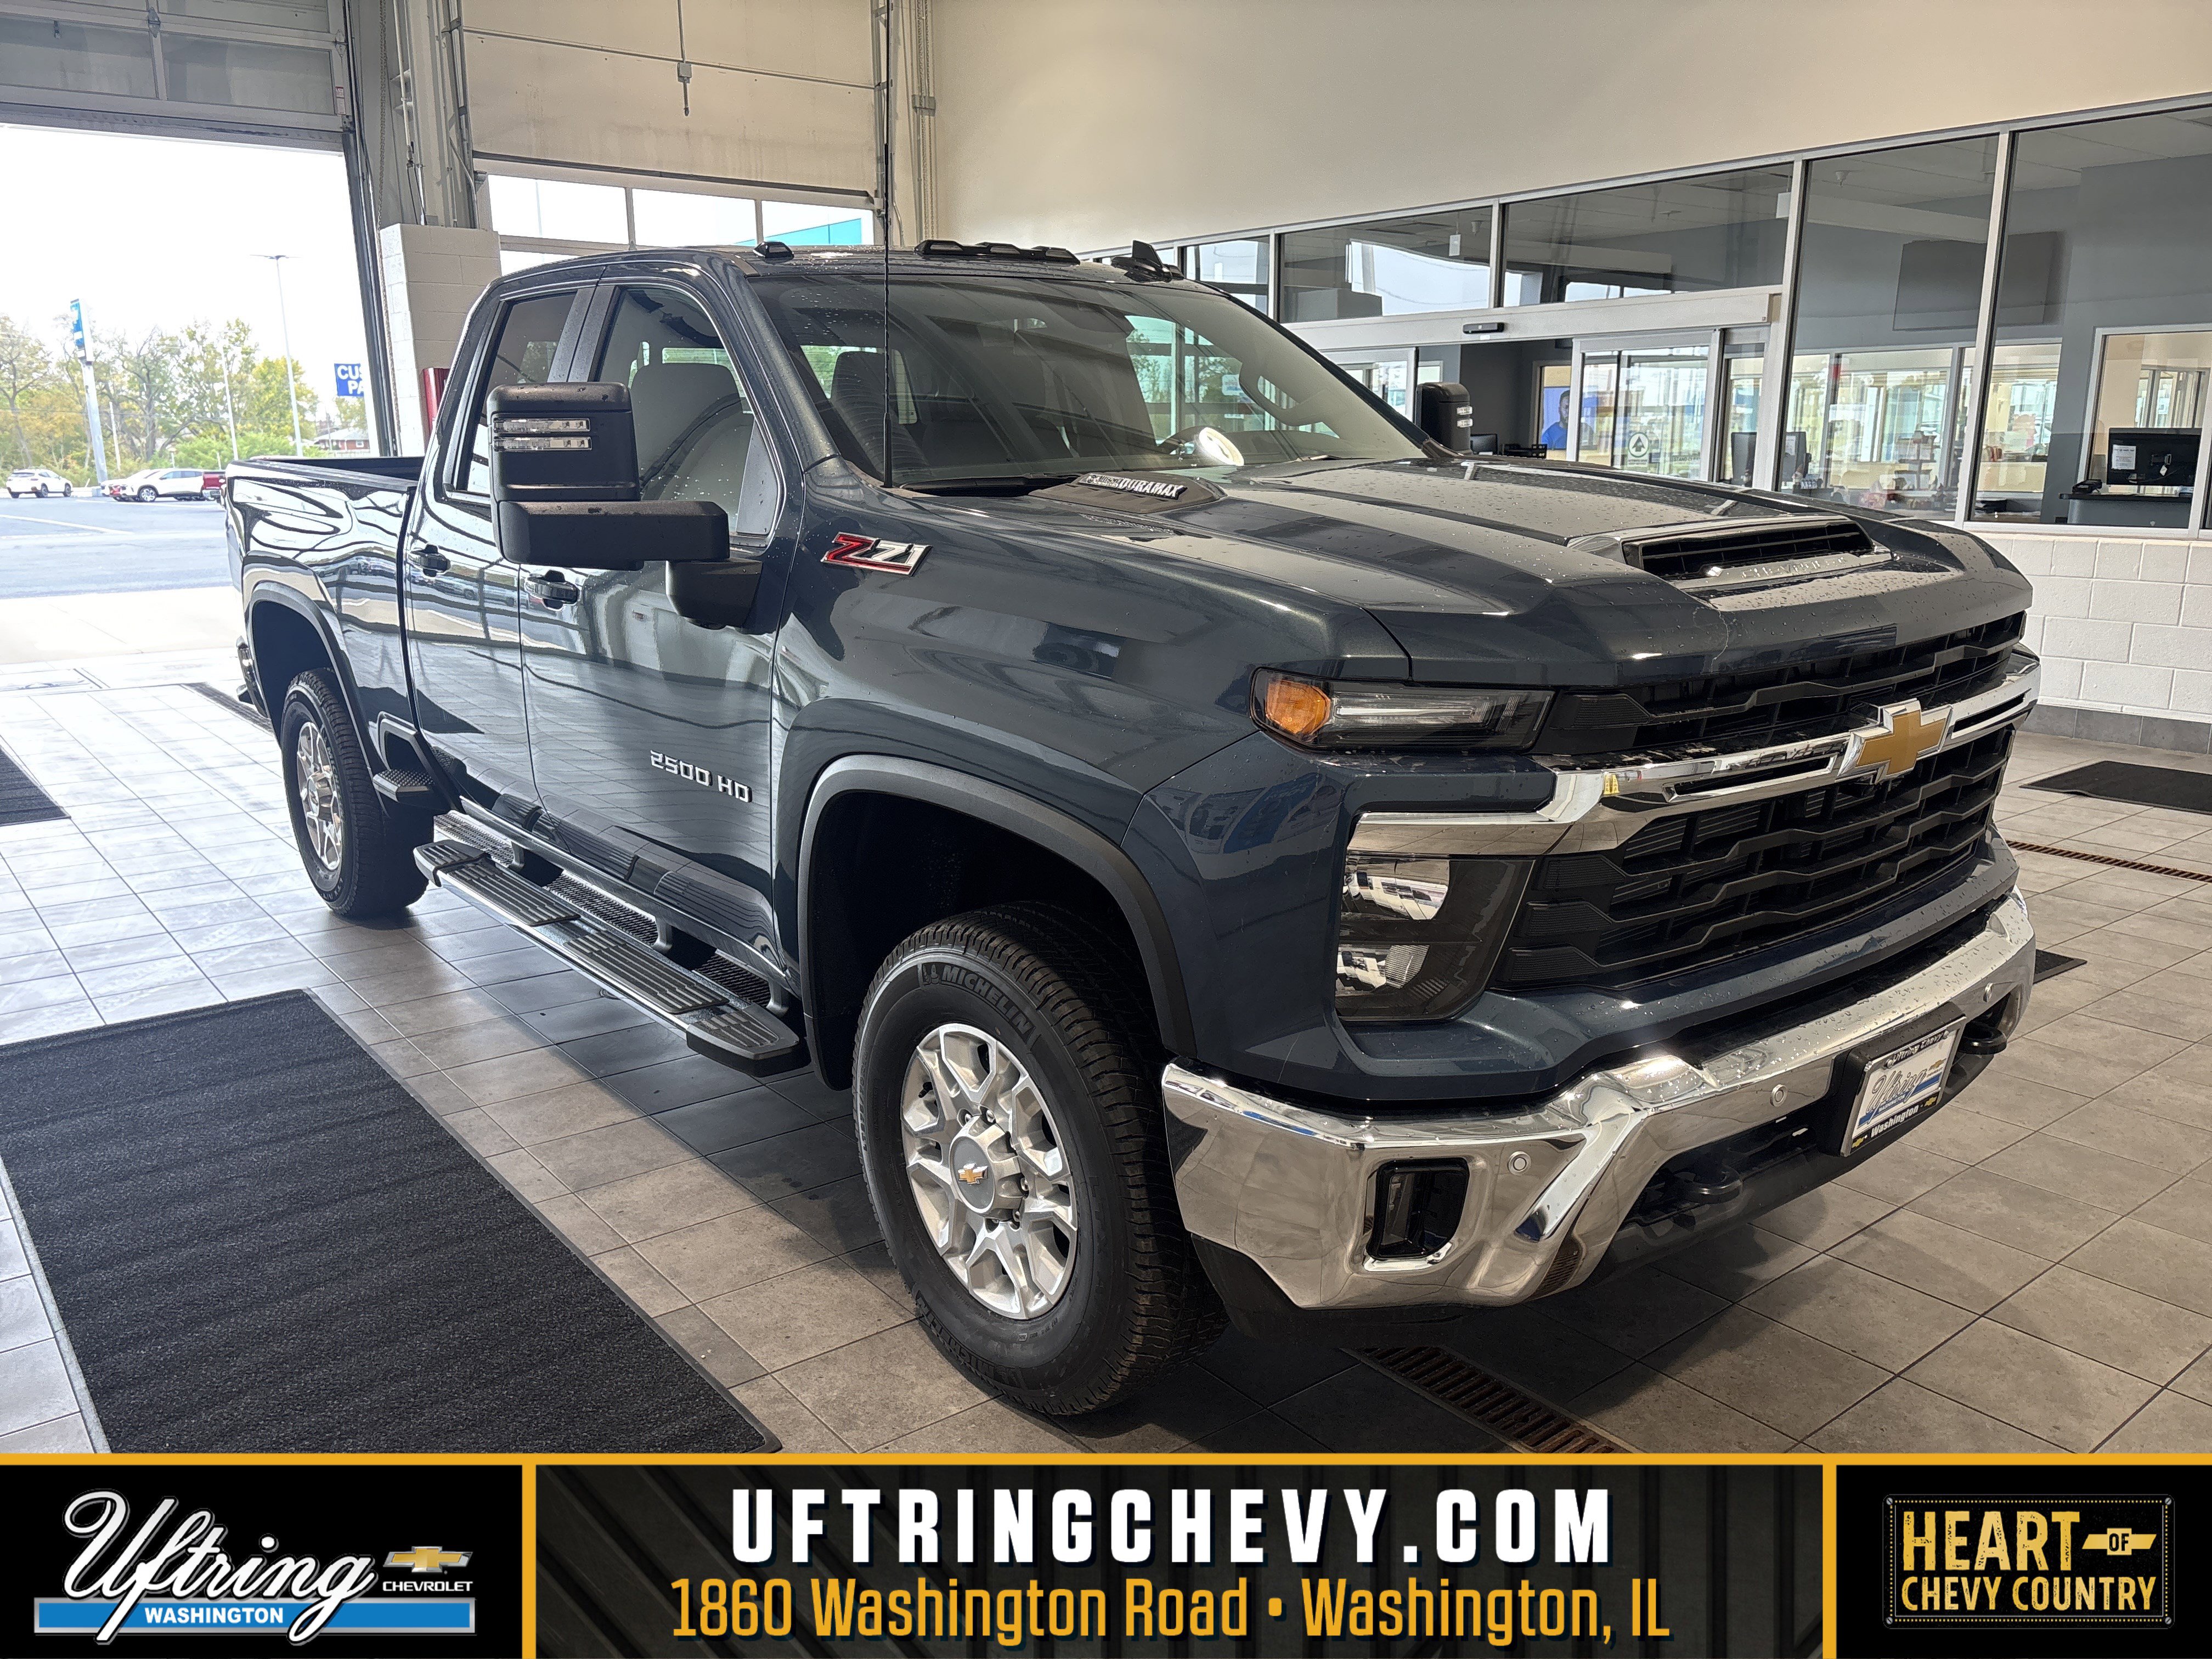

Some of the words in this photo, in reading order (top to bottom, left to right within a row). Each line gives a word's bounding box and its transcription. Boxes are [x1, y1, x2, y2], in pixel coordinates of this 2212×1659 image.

[1118, 477, 1184, 498] DURAMAX
[821, 532, 933, 576] Z71
[650, 749, 712, 787] 2500
[718, 774, 752, 803] HD
[941, 964, 1034, 1035] MICHELIN
[1866, 1068, 1927, 1125] Uftring
[1871, 1104, 1919, 1138] Washington
